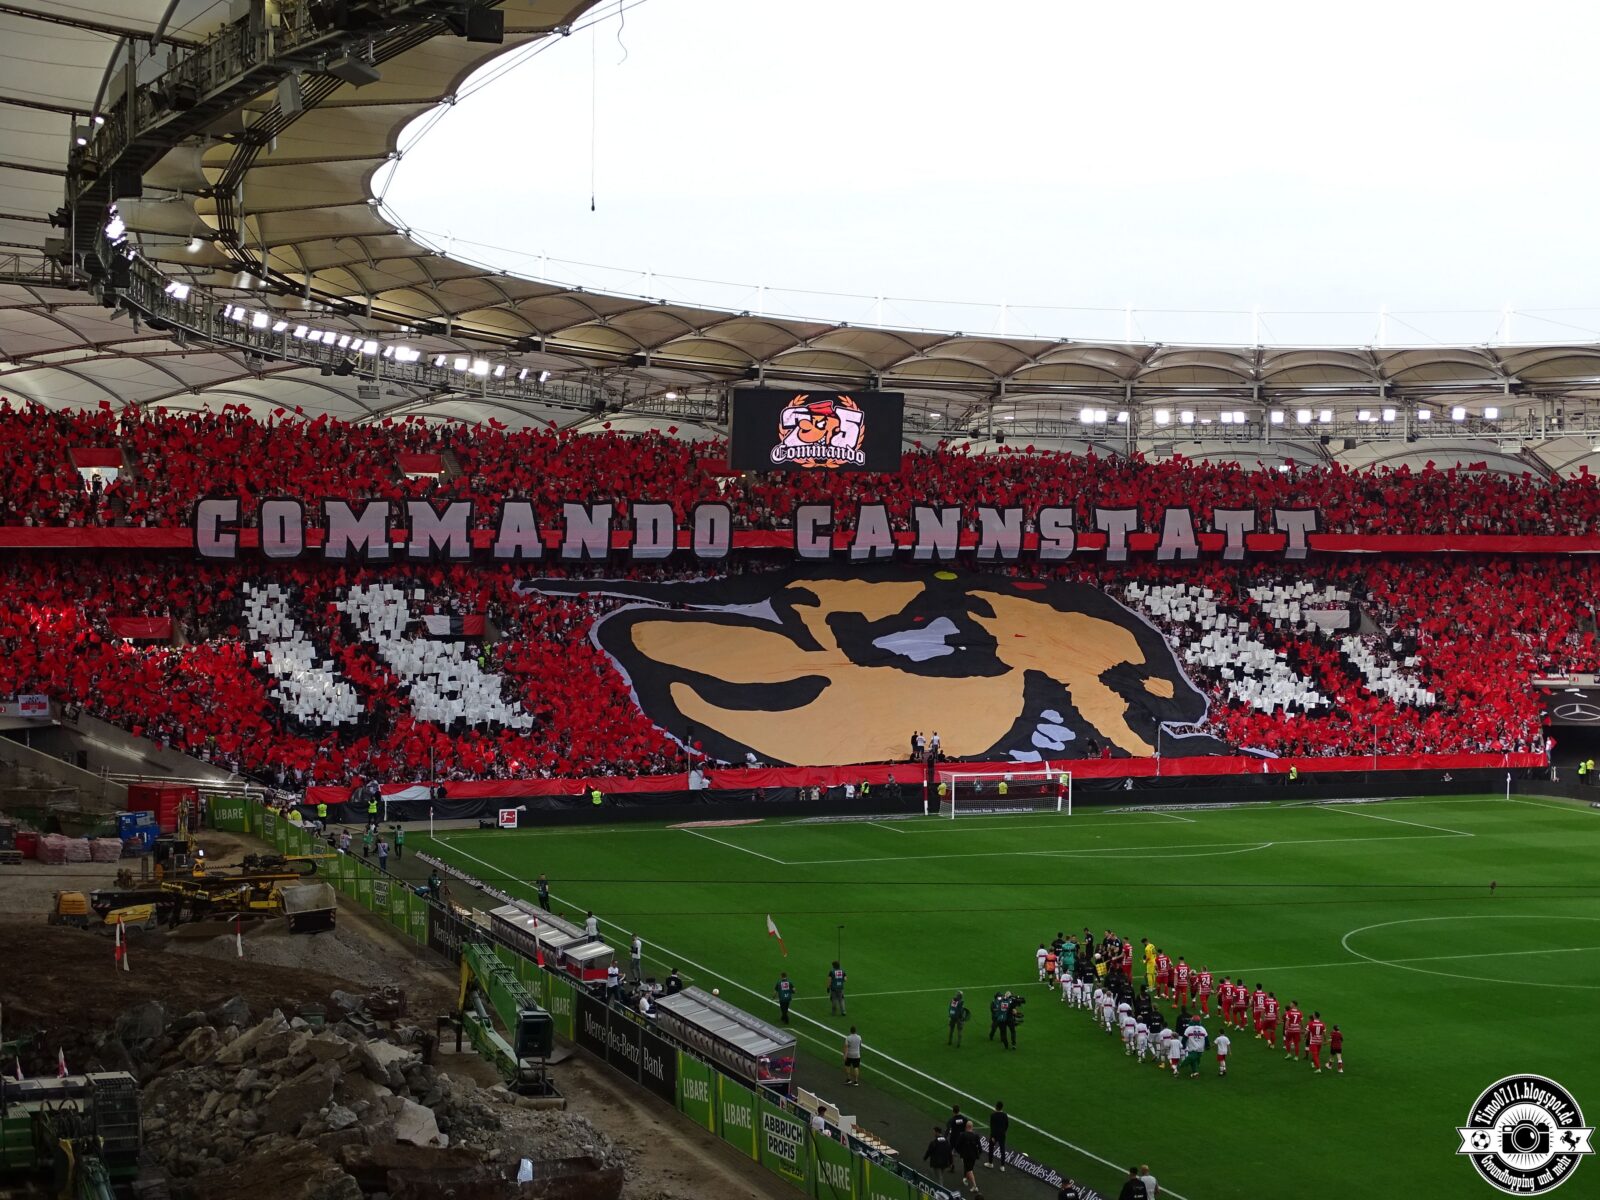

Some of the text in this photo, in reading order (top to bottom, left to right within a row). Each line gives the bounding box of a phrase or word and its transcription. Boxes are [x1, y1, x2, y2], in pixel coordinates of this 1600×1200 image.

[771, 445, 865, 465] Commando
[197, 499, 1317, 561] COMMANDO CANNSTATT
[214, 807, 243, 820] LIBARE
[1202, 976, 1210, 986] 24
[585, 1010, 640, 1065] Mercedes-Benz
[643, 1046, 664, 1080] Bank
[683, 1078, 708, 1103] LIBARE
[723, 1102, 752, 1130] LIBARE
[764, 1114, 803, 1145] ABBRUCH
[768, 1136, 795, 1160] PROFIS
[817, 1158, 851, 1192] LIBARE
